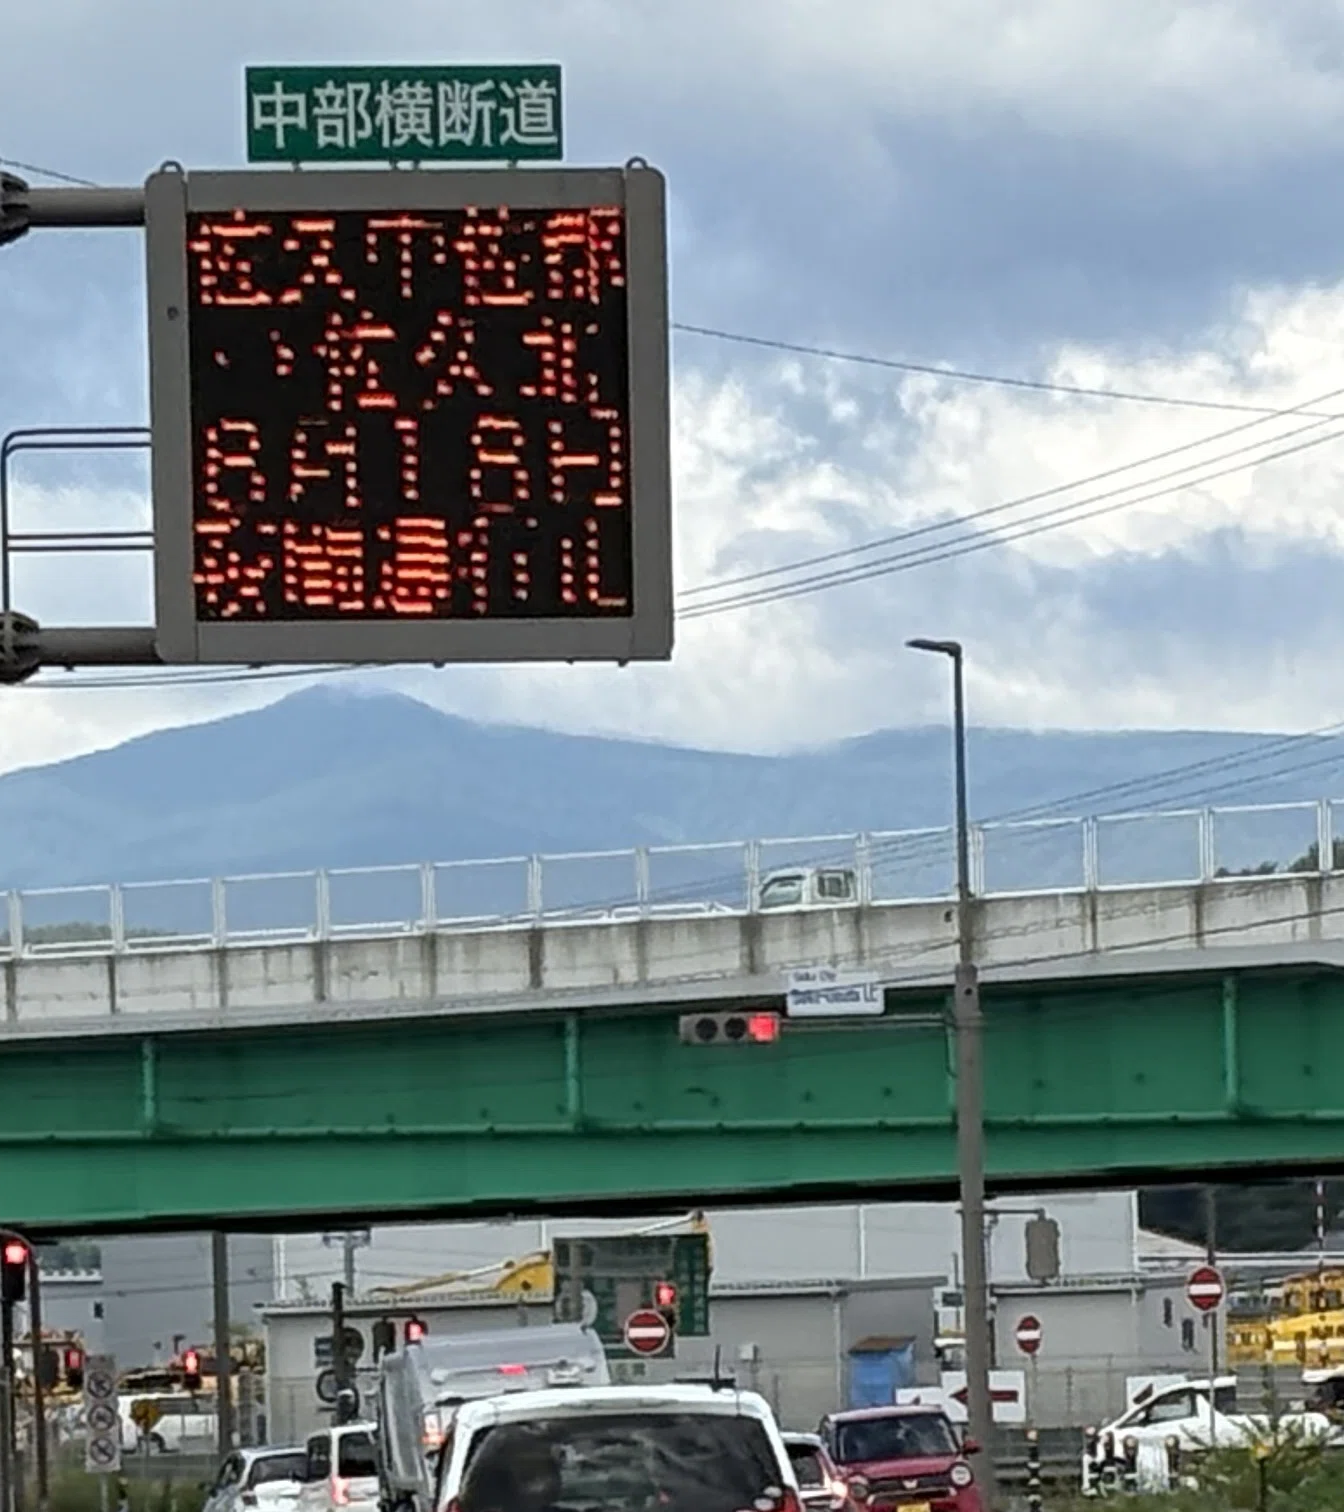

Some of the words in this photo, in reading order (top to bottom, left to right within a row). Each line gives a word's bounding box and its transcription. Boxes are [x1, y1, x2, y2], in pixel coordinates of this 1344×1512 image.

[252, 79, 558, 150] 中部横断道
